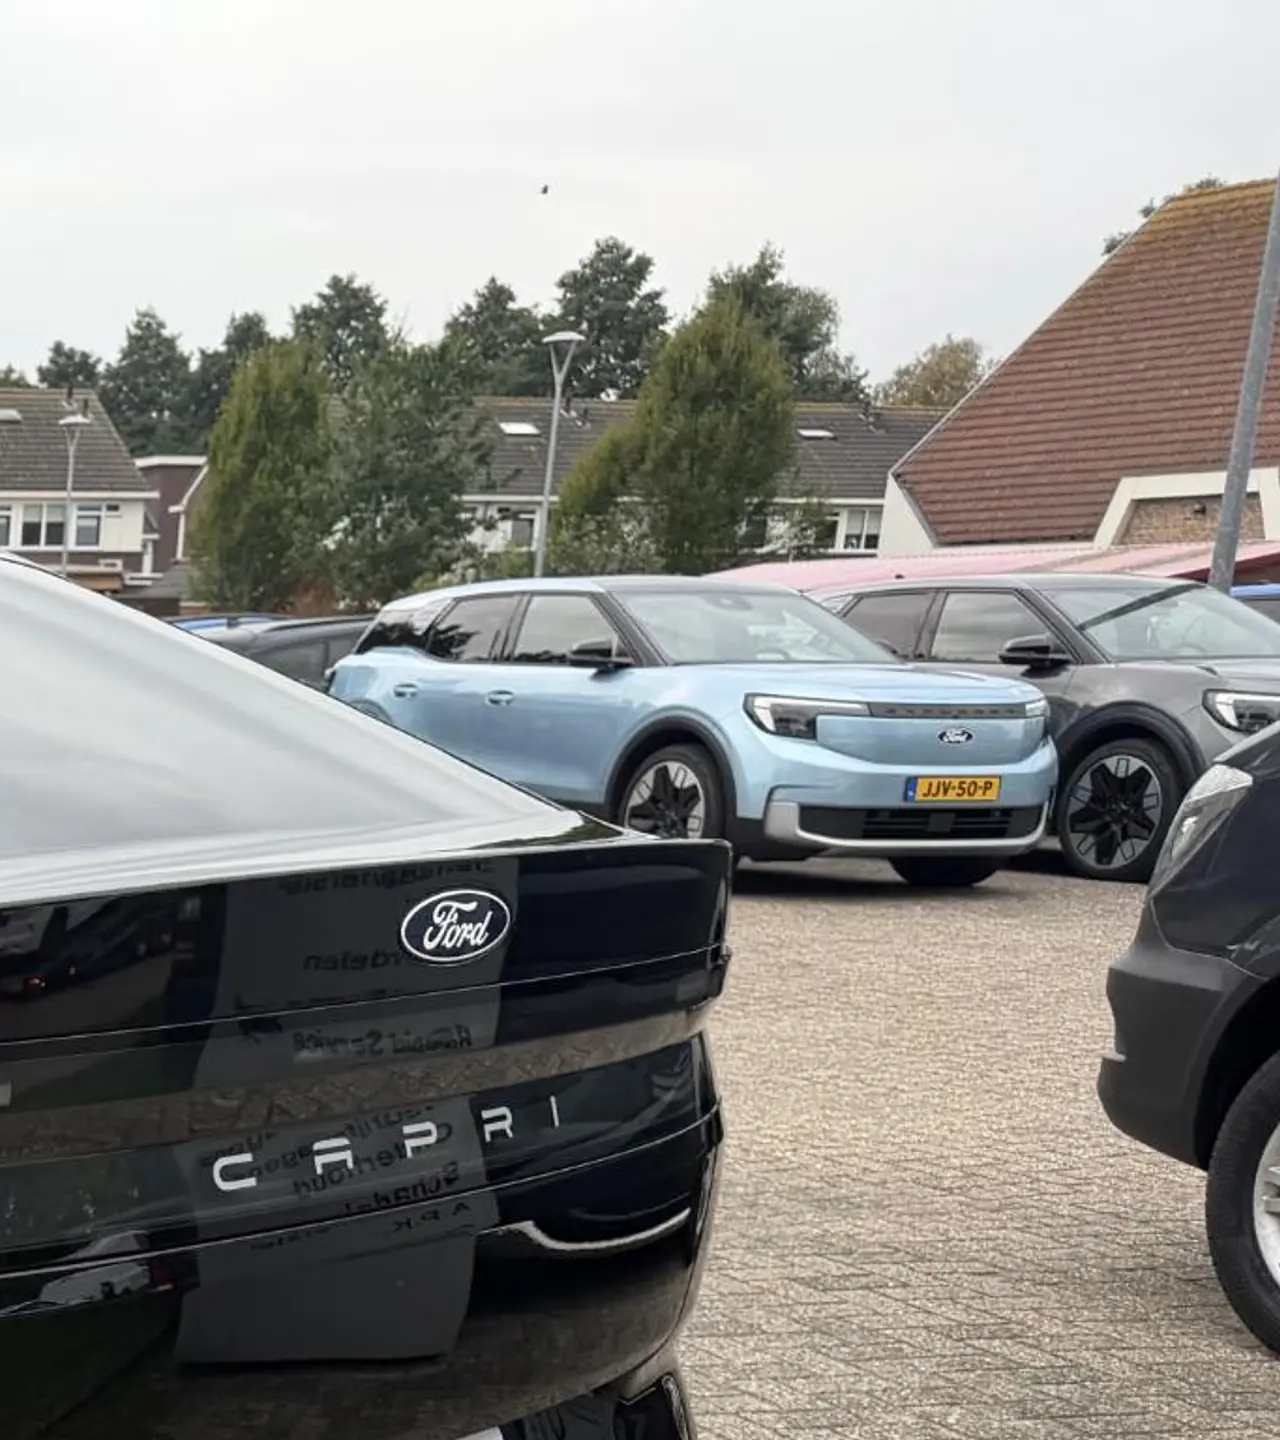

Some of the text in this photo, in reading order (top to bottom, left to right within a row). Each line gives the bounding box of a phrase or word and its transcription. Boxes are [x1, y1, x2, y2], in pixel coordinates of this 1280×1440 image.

[921, 780, 993, 798] JJV-50-P
[423, 900, 493, 950] Ford
[211, 1095, 560, 1191] CAPRI
